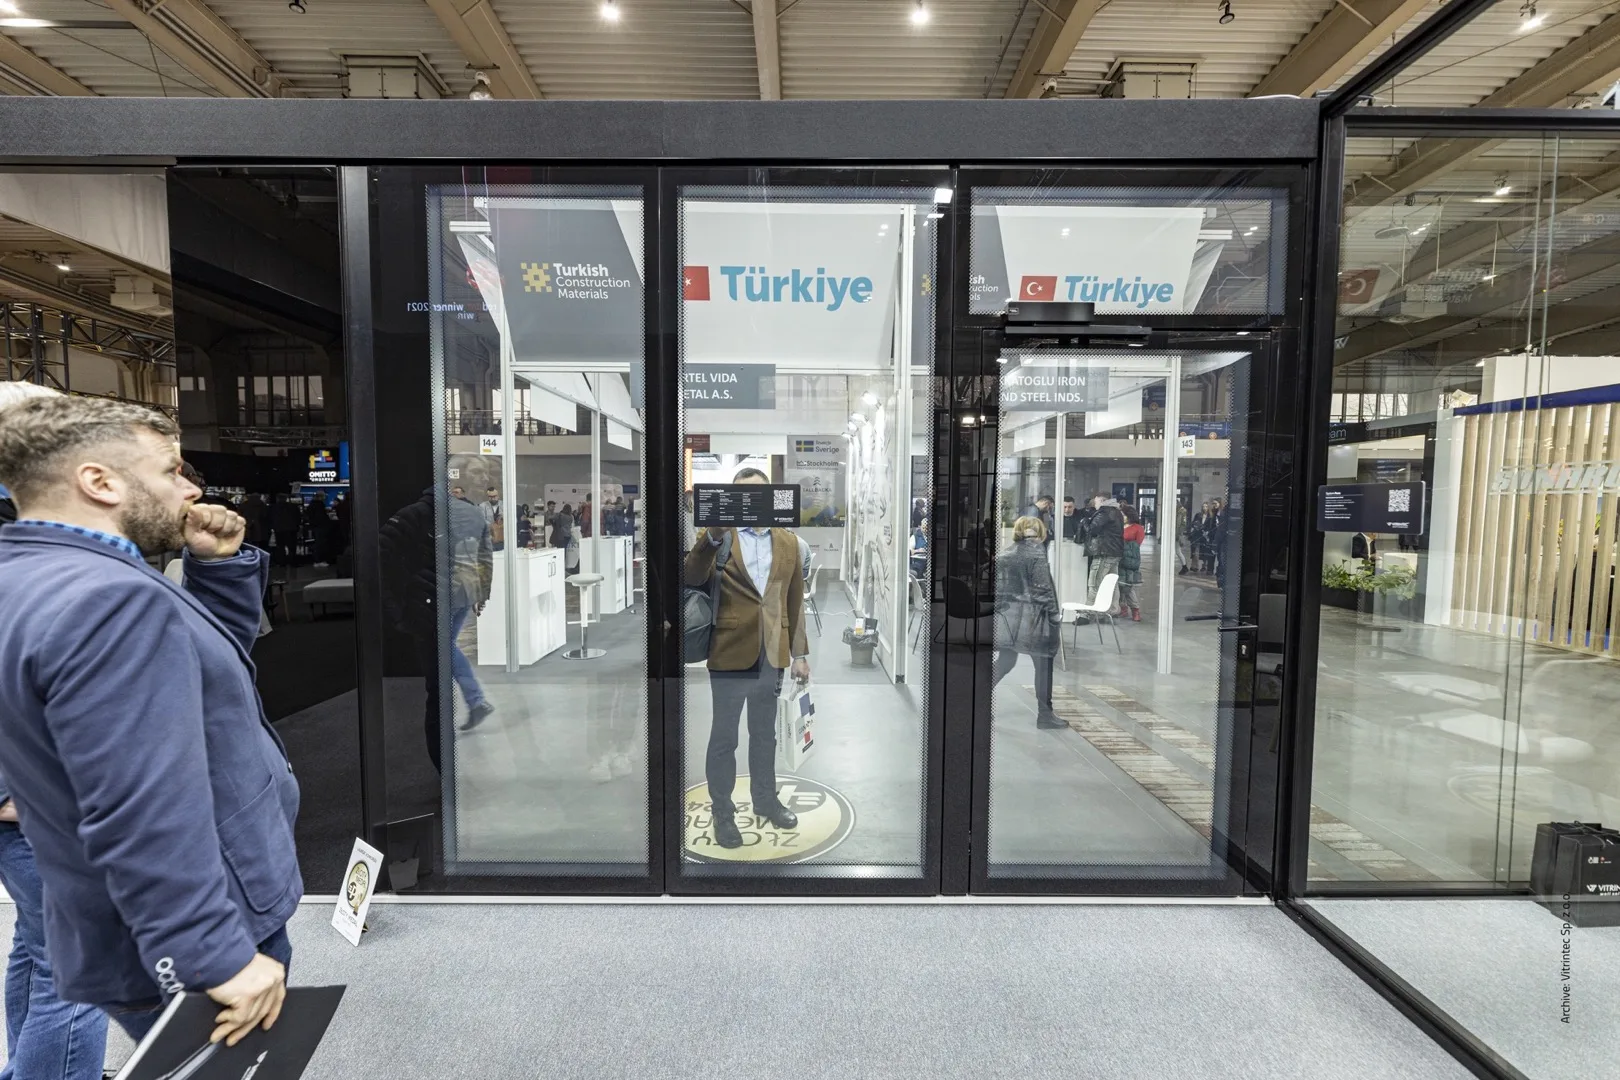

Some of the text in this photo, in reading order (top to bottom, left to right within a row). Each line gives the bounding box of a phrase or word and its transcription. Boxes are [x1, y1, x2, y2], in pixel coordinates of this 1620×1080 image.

[553, 262, 609, 277] Turkish
[555, 276, 631, 289] Construction
[558, 288, 609, 300] Materials
[720, 265, 873, 312] Türkiye
[1064, 275, 1174, 309] Türkiye
[710, 373, 738, 383] VIDA
[1058, 376, 1086, 387] IRON
[711, 389, 733, 400] A.S.
[1020, 392, 1051, 403] STEEL
[1054, 392, 1084, 403] INDS.
[1329, 428, 1347, 439] am
[482, 438, 497, 447] 144
[1181, 439, 1194, 449] 143
[815, 446, 840, 455] Sverige
[1119, 487, 1127, 498] 4
[692, 830, 801, 848] ZŁOY
